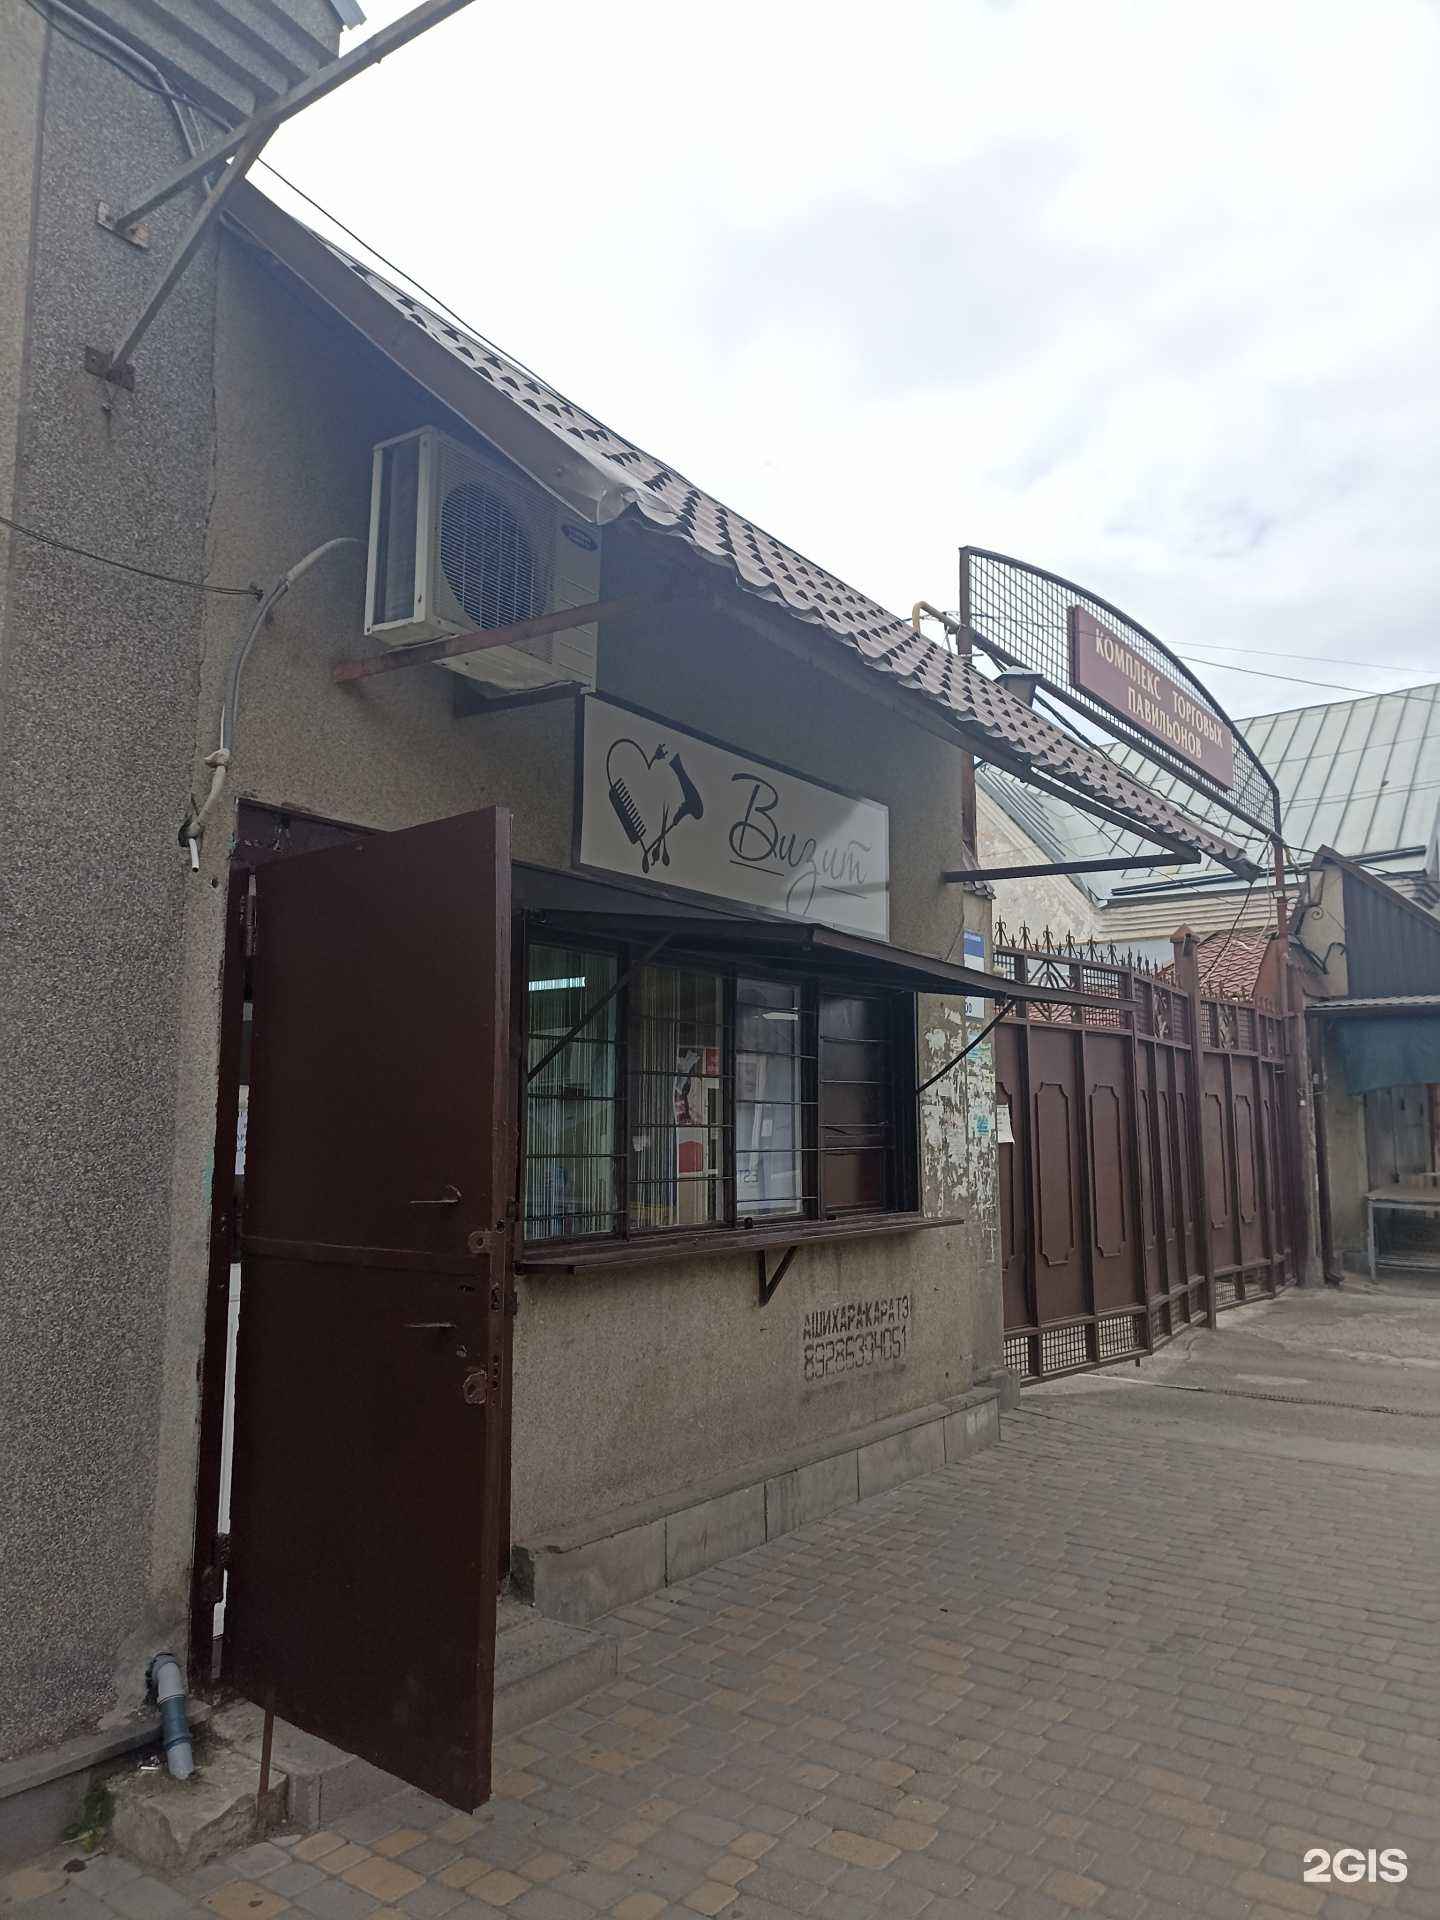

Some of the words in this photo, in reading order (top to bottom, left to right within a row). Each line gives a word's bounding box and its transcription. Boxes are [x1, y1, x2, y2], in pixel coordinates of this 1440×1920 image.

[1095, 629, 1161, 700] КОМПЛЕКС
[1172, 690, 1224, 748] ТОРГОВЫХ
[1128, 685, 1202, 758] ПАВИЛЬОНОВ
[729, 772, 871, 917] Визит
